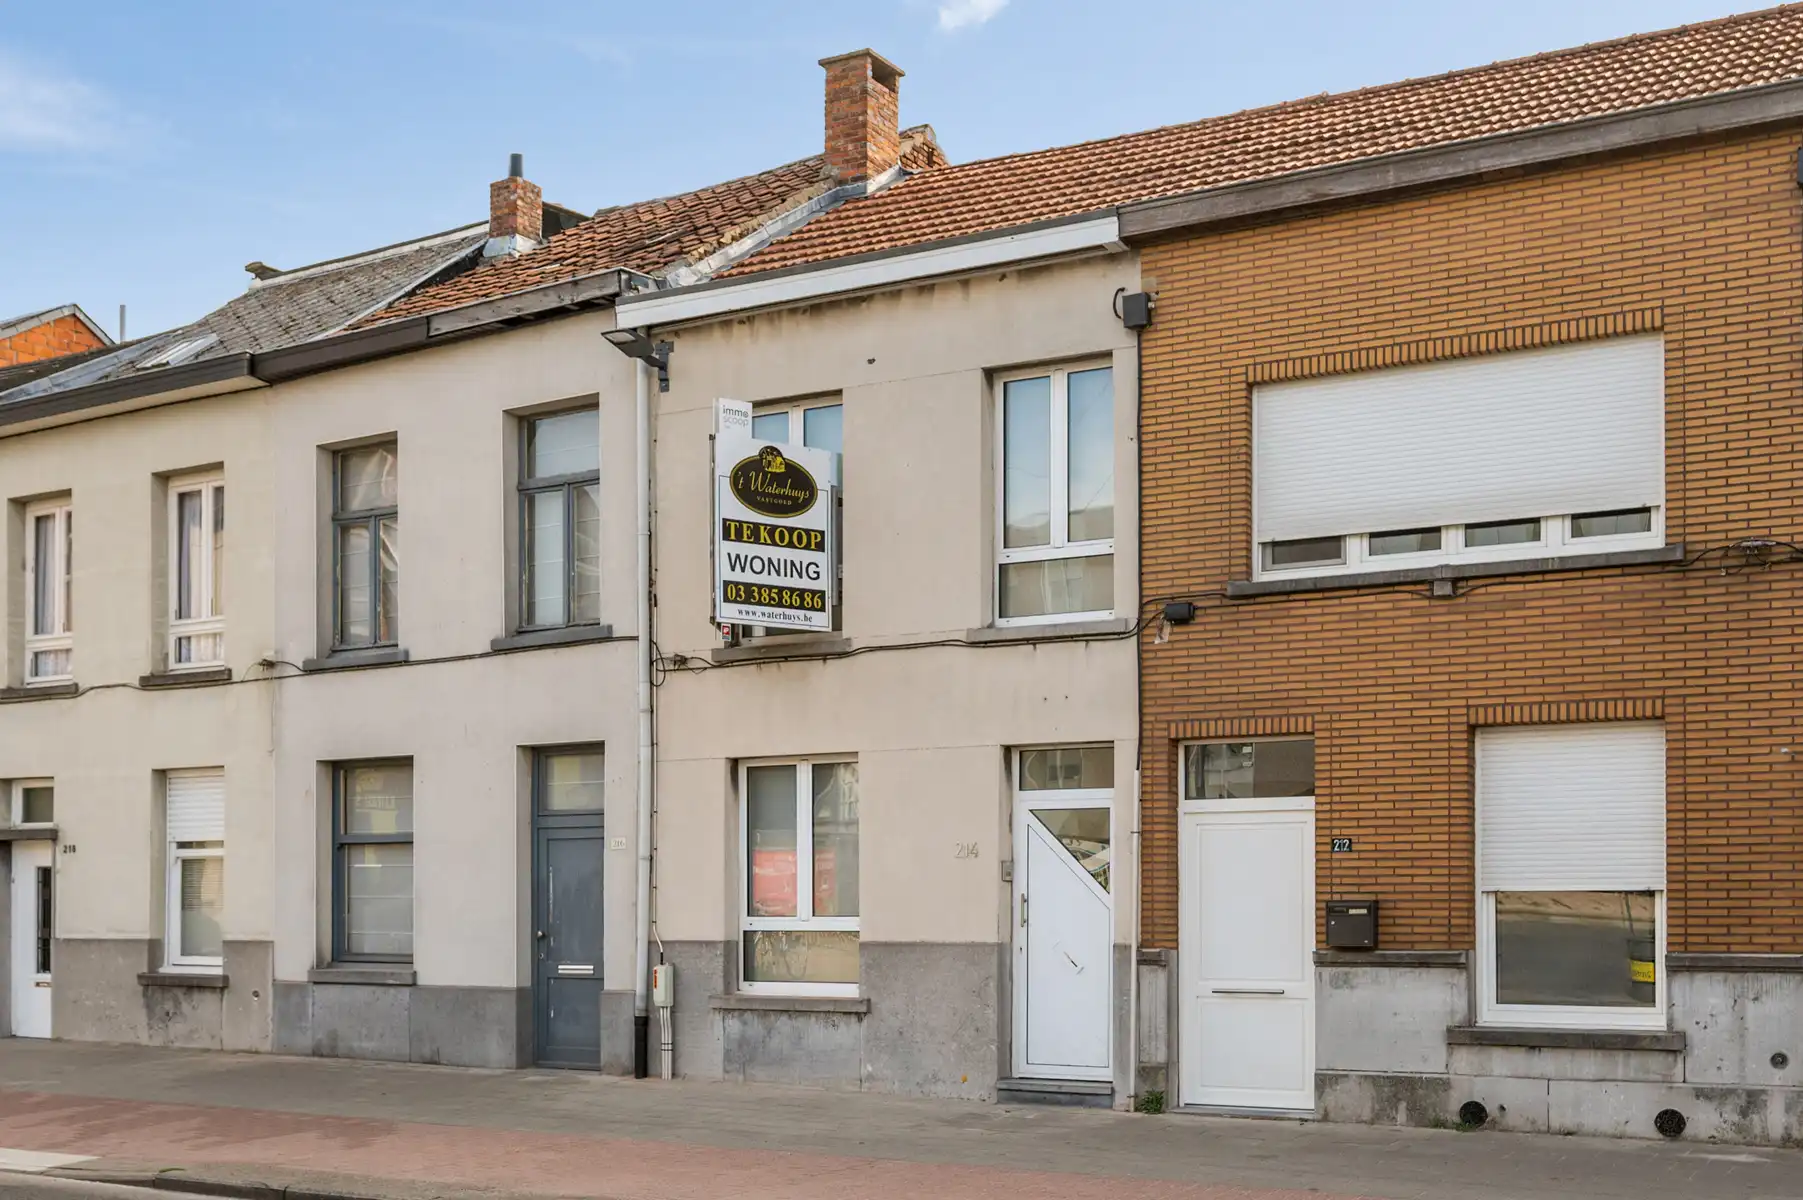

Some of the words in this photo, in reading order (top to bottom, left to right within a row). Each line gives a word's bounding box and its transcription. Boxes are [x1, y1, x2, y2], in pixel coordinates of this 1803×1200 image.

[723, 415, 749, 428] scoop
[749, 470, 810, 504] Waterhuys
[756, 495, 792, 506] VASTGOED
[727, 552, 821, 581] WONING
[726, 583, 745, 601] 03
[750, 586, 779, 605] 385
[782, 589, 800, 607] 86
[803, 591, 822, 609] 86
[737, 608, 813, 623] www.waterhuys.be
[63, 844, 76, 854] 218
[612, 839, 625, 848] 216
[954, 841, 979, 859] 214
[1333, 839, 1350, 852] 212
